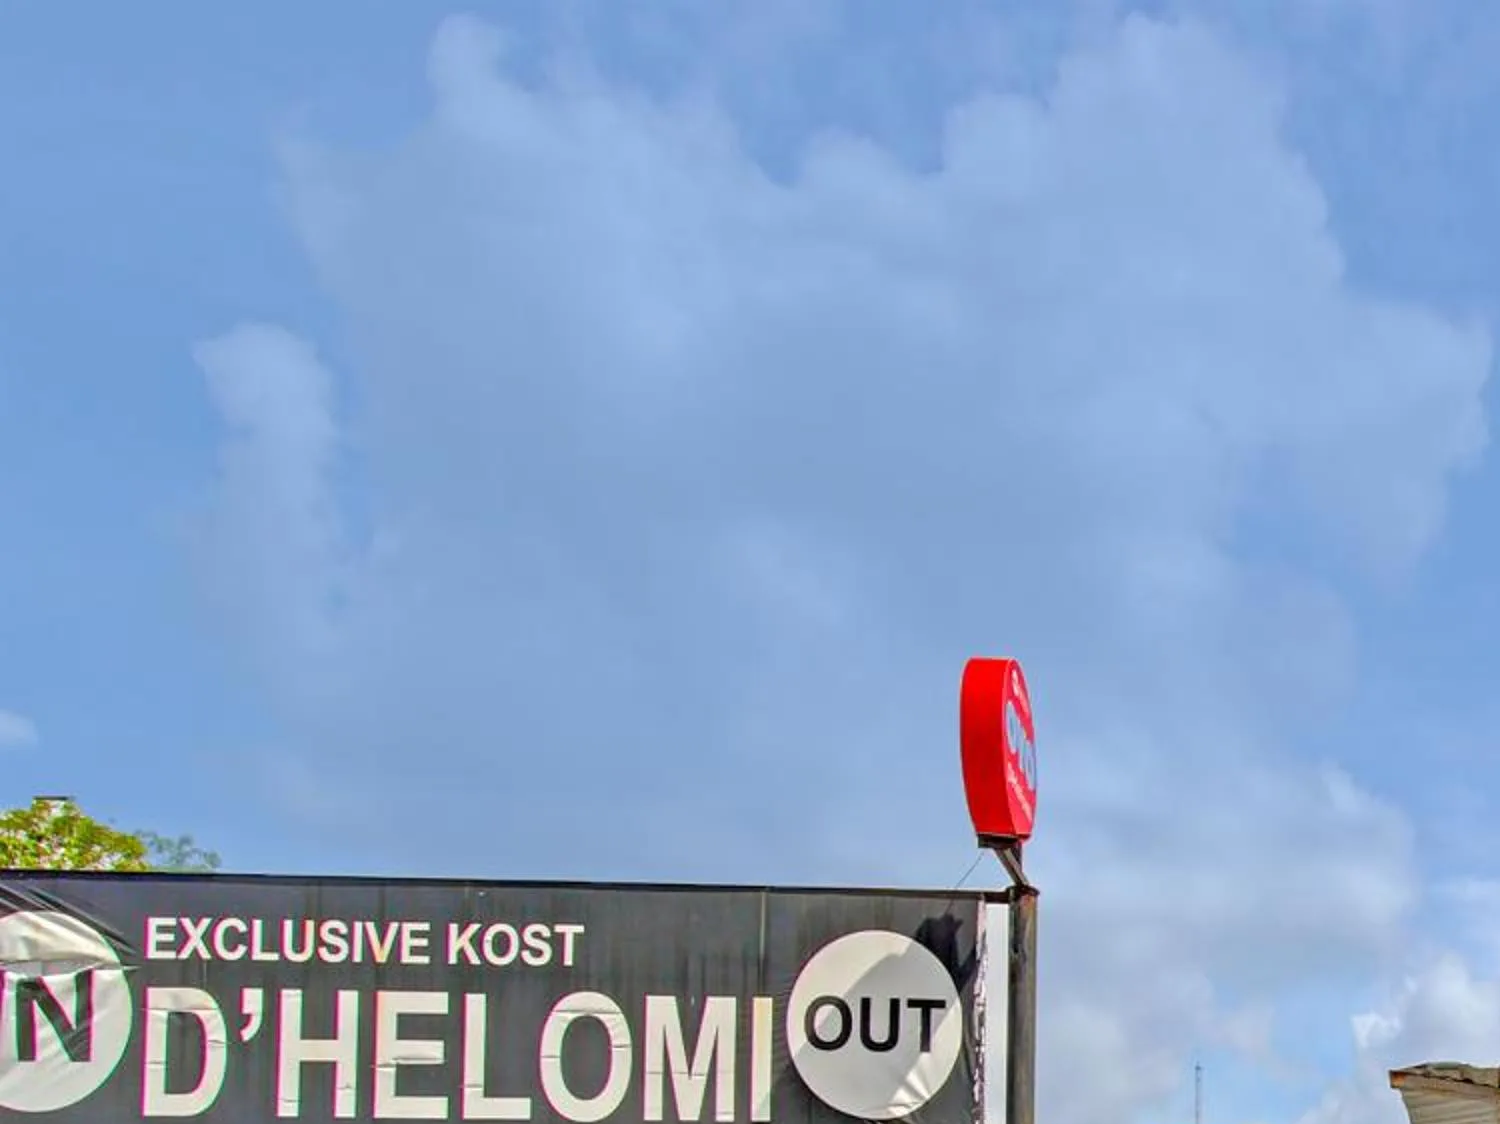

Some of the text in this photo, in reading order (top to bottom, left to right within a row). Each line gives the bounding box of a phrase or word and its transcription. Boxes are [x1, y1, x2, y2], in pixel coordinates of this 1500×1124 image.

[144, 916, 585, 966] EXCLUSIVE KOST
[0, 967, 95, 1063] N
[803, 995, 946, 1052] OUT
[141, 986, 774, 1123] D'HELOMI
